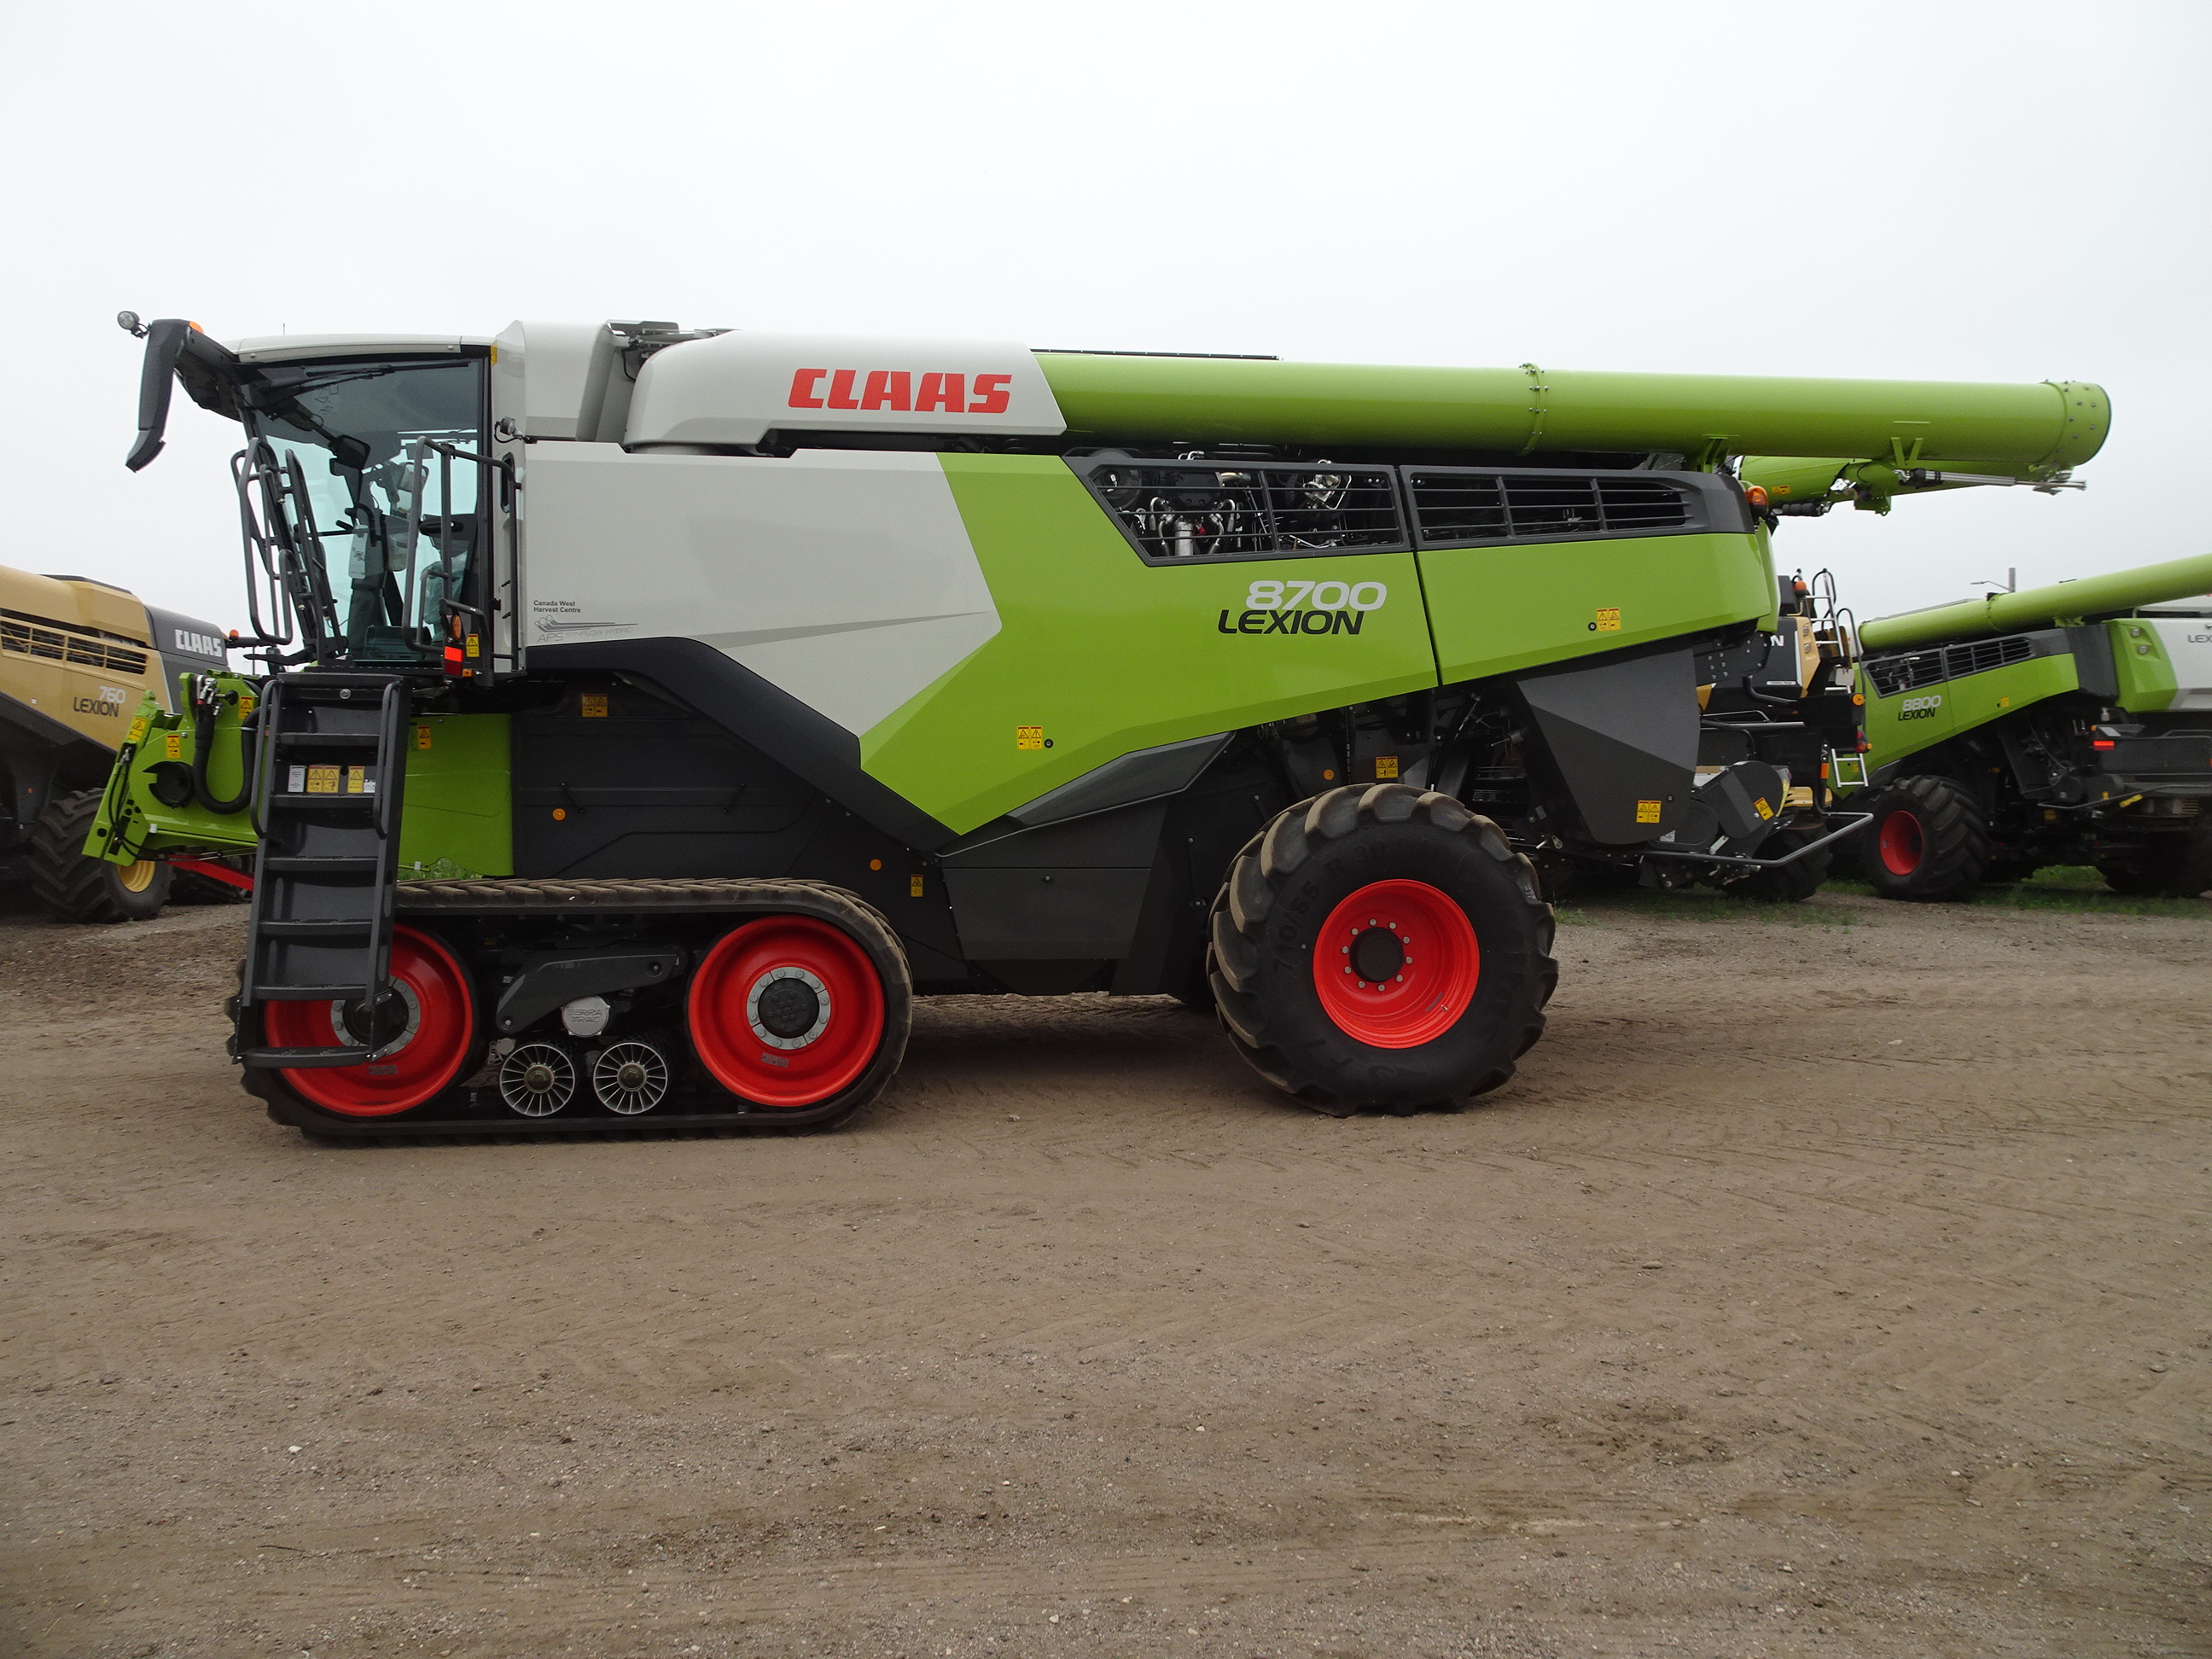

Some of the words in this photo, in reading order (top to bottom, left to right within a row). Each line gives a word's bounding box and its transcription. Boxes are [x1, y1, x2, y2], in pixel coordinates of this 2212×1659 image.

[788, 368, 1013, 414] CLAAS
[1245, 580, 1388, 611] 8700
[1218, 609, 1365, 635] LEXION
[175, 629, 223, 657] CLAAS
[537, 632, 564, 643] APS
[99, 686, 125, 703] 760
[1902, 695, 1942, 712] 8800
[73, 697, 119, 717] LEXION
[1897, 707, 1936, 722] LEXION
